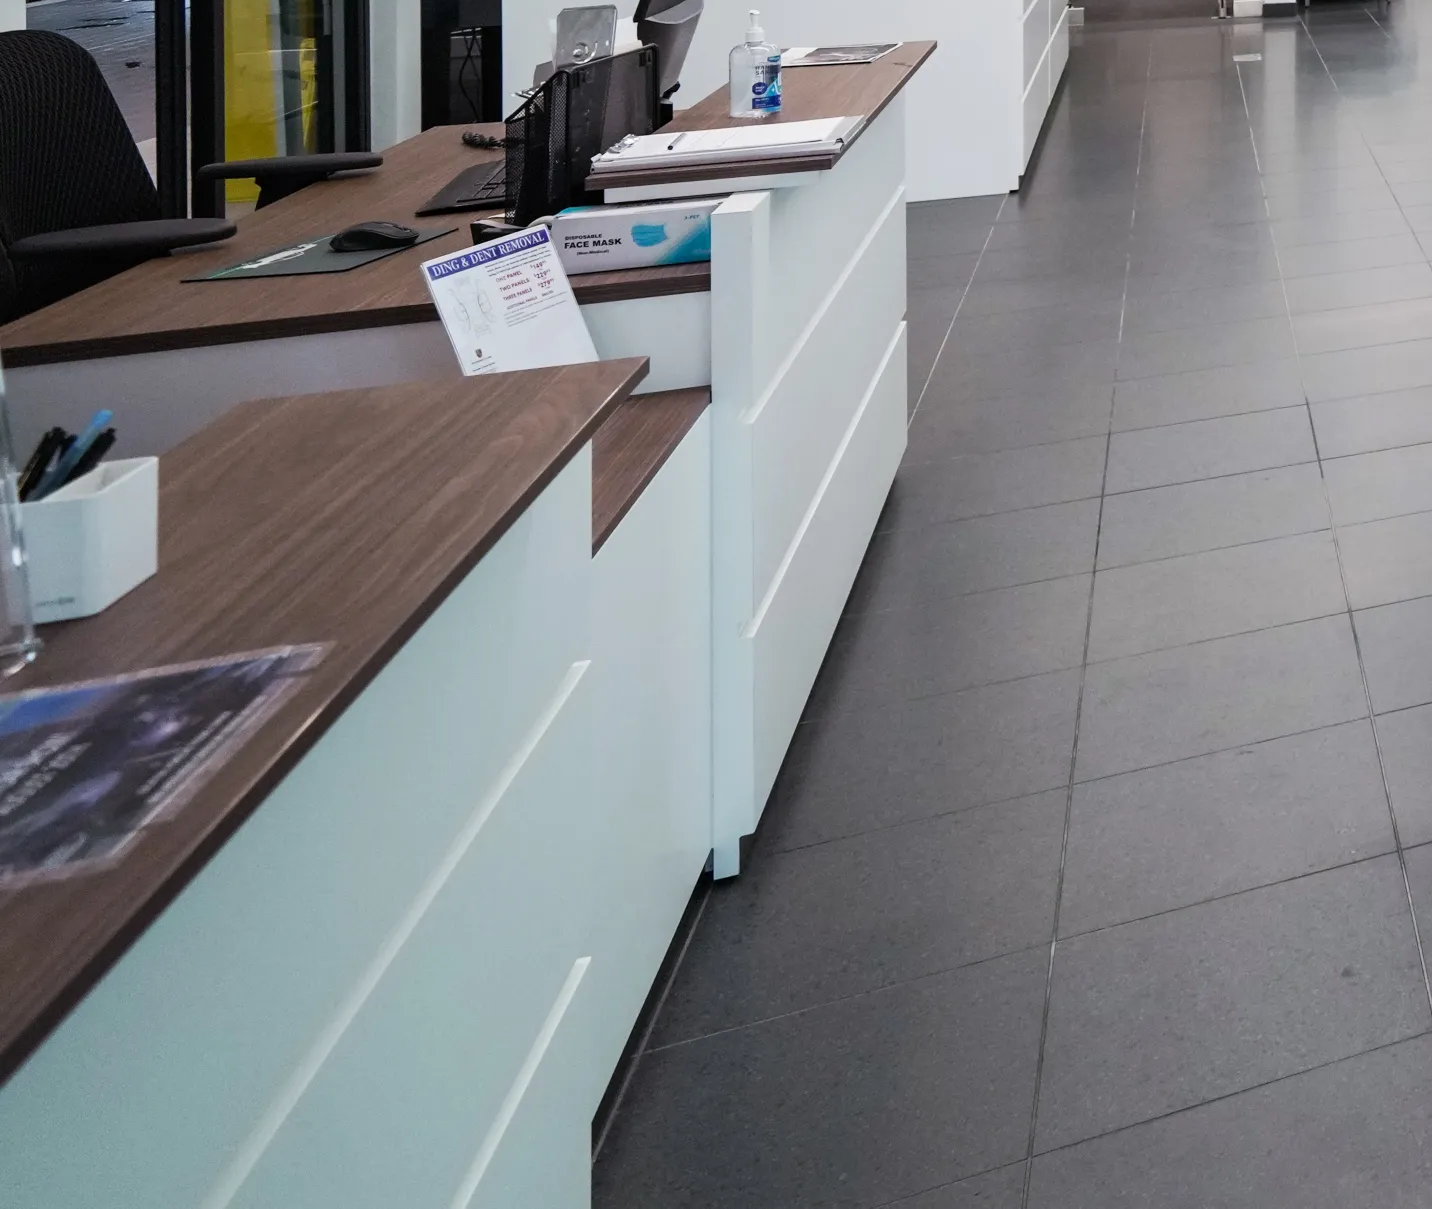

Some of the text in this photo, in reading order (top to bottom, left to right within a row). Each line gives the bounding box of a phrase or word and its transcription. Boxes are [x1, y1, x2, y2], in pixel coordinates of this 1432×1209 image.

[564, 238, 622, 249] FACE MASK
[432, 259, 460, 277] DING
[461, 256, 470, 267] &
[470, 246, 497, 265] DENT
[498, 231, 545, 255] REMOVAL
[506, 270, 523, 280] PANEL
[499, 283, 511, 292] TWO
[511, 278, 530, 289] PANELS
